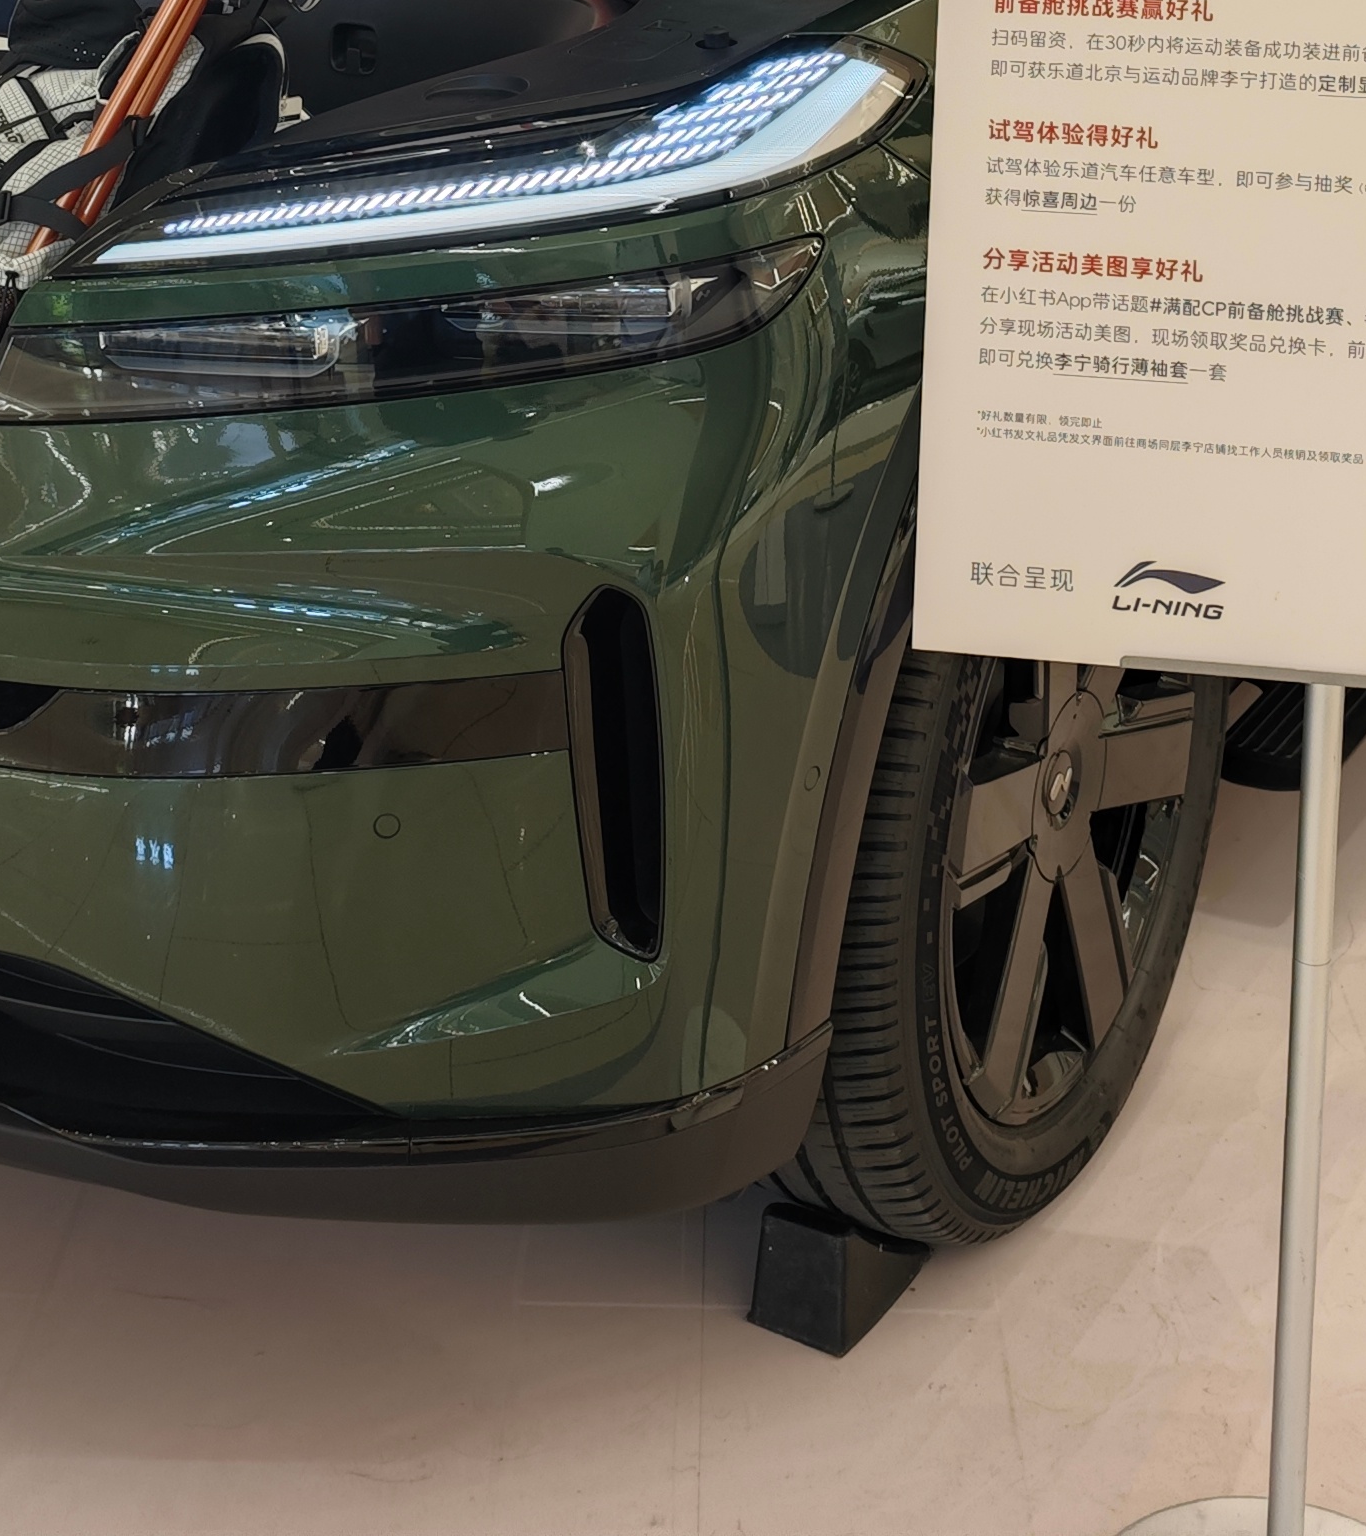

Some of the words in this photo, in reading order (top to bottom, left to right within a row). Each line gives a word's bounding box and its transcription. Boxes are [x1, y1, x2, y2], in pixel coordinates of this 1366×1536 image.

[988, 118, 1159, 150] 试驾体验得好礼
[984, 187, 1137, 214] 获得惊喜周边一份
[982, 246, 1204, 283] 分享活动美图享好礼
[978, 348, 1227, 383] 即可兑换李宁骑行薄袖套一套
[970, 561, 1074, 592] 联合呈现
[1111, 595, 1225, 620] LI-NING
[925, 1016, 949, 1107] SPORT
[940, 1115, 974, 1172] PILOT
[973, 1146, 1084, 1210] MICHELIN
